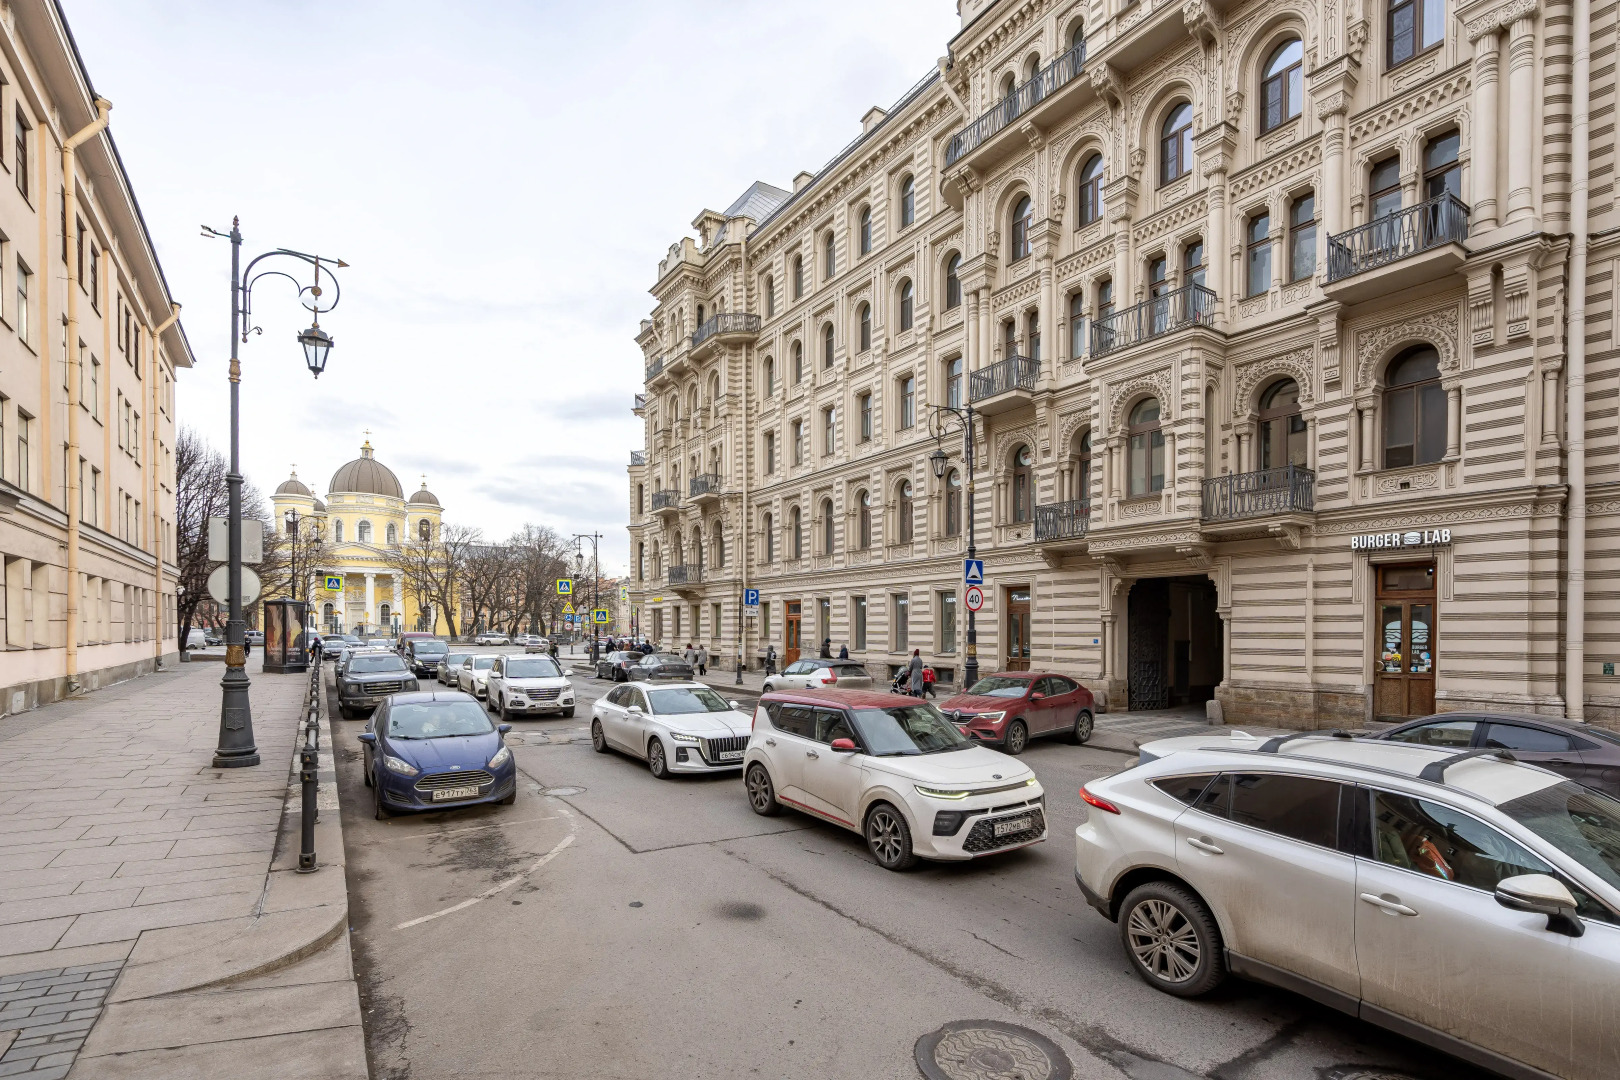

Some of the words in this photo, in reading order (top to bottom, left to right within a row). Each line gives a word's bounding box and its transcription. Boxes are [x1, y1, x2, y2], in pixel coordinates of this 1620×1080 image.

[1351, 533, 1401, 549] BURGER
[1424, 529, 1451, 544] LAB
[748, 591, 757, 604] P
[969, 594, 980, 604] 40
